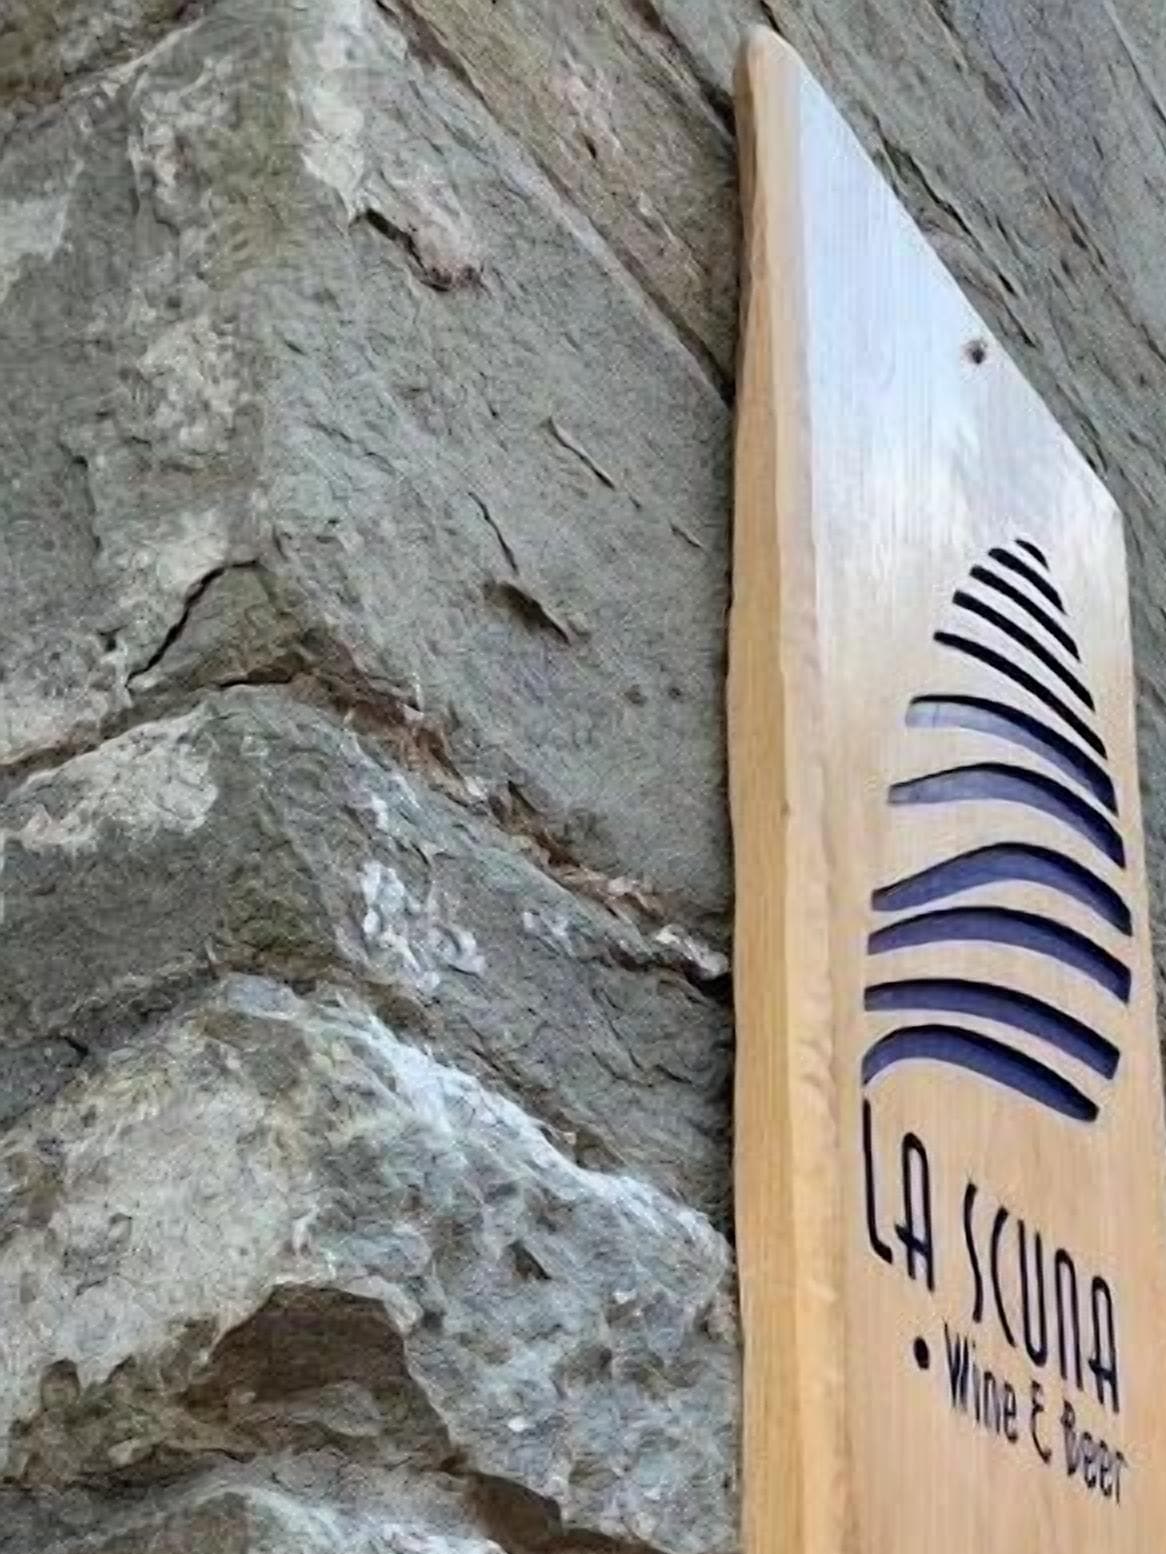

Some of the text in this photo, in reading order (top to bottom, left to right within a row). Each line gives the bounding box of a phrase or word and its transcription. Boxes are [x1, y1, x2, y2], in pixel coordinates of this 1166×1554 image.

[861, 1098, 1121, 1414] LA SCUNA
[943, 1320, 1018, 1444] Wine
[1060, 1398, 1128, 1505] Beer
